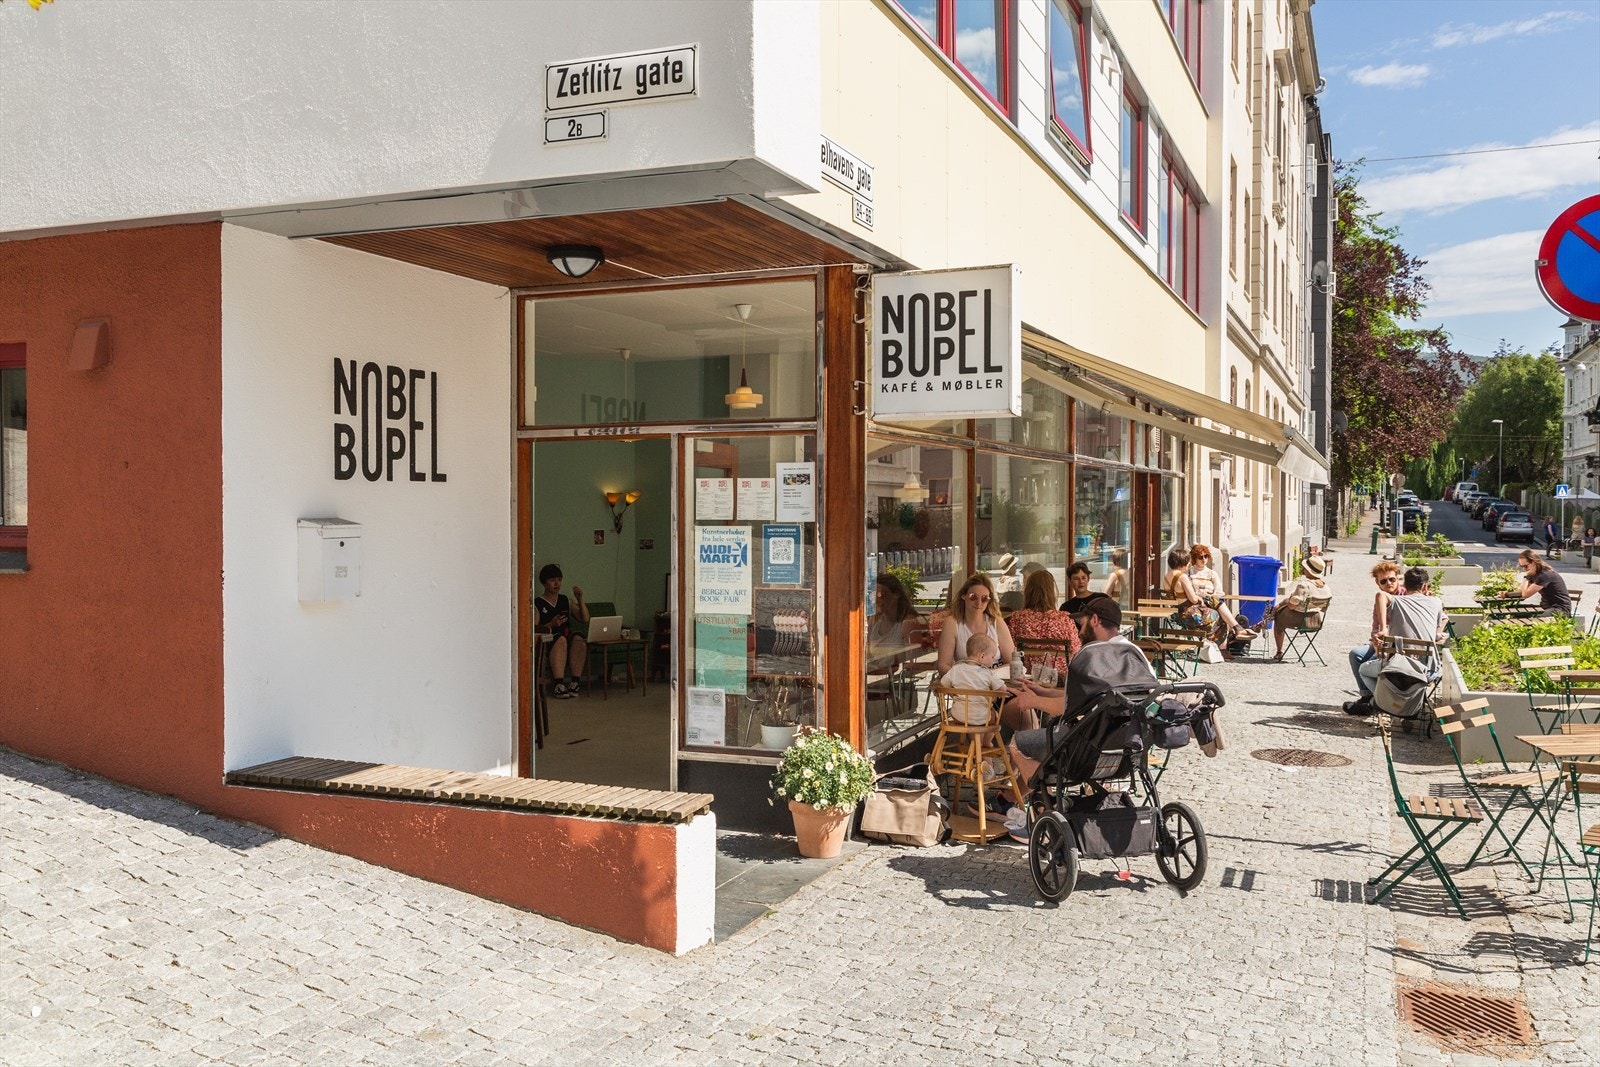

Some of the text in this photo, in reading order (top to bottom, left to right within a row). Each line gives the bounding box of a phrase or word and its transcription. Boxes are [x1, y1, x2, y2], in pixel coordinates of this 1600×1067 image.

[556, 56, 683, 98] Zetlitz gate
[567, 119, 583, 138] 2B
[820, 140, 871, 191] elhavens gate
[881, 379, 1003, 393] KAFÉ & MØBLER
[700, 554, 740, 564] MART
[701, 588, 730, 596] BERGEN
